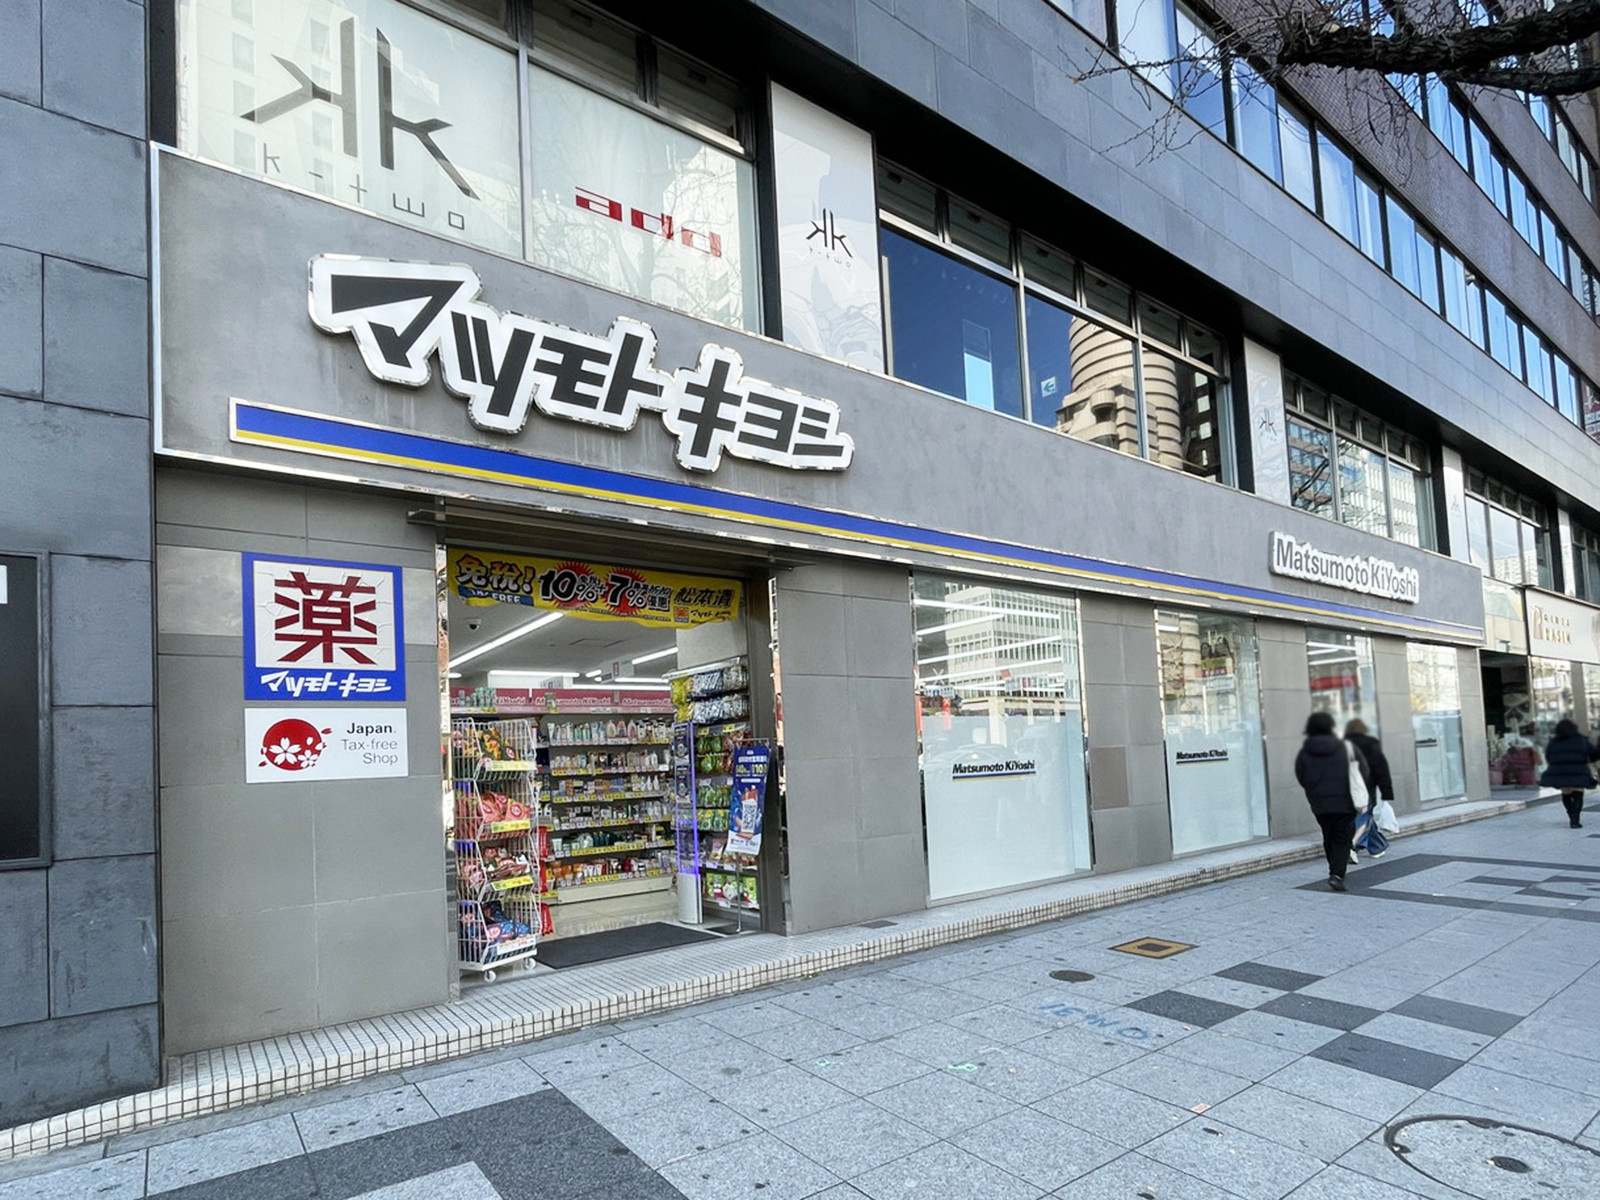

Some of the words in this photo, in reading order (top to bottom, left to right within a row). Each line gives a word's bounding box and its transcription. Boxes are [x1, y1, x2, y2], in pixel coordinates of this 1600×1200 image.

[575, 186, 722, 258] add
[331, 273, 848, 458] マツモトキヨシ
[1276, 537, 1369, 587] Matsumoto
[1370, 562, 1418, 598] KiYoshi
[274, 571, 379, 665] 薬
[260, 670, 392, 697] マツモトキヨシ
[341, 738, 398, 751] Tax-free
[363, 752, 398, 765] Shop
[953, 762, 1004, 774] Matsumoto
[1004, 759, 1035, 773] KiYoshi
